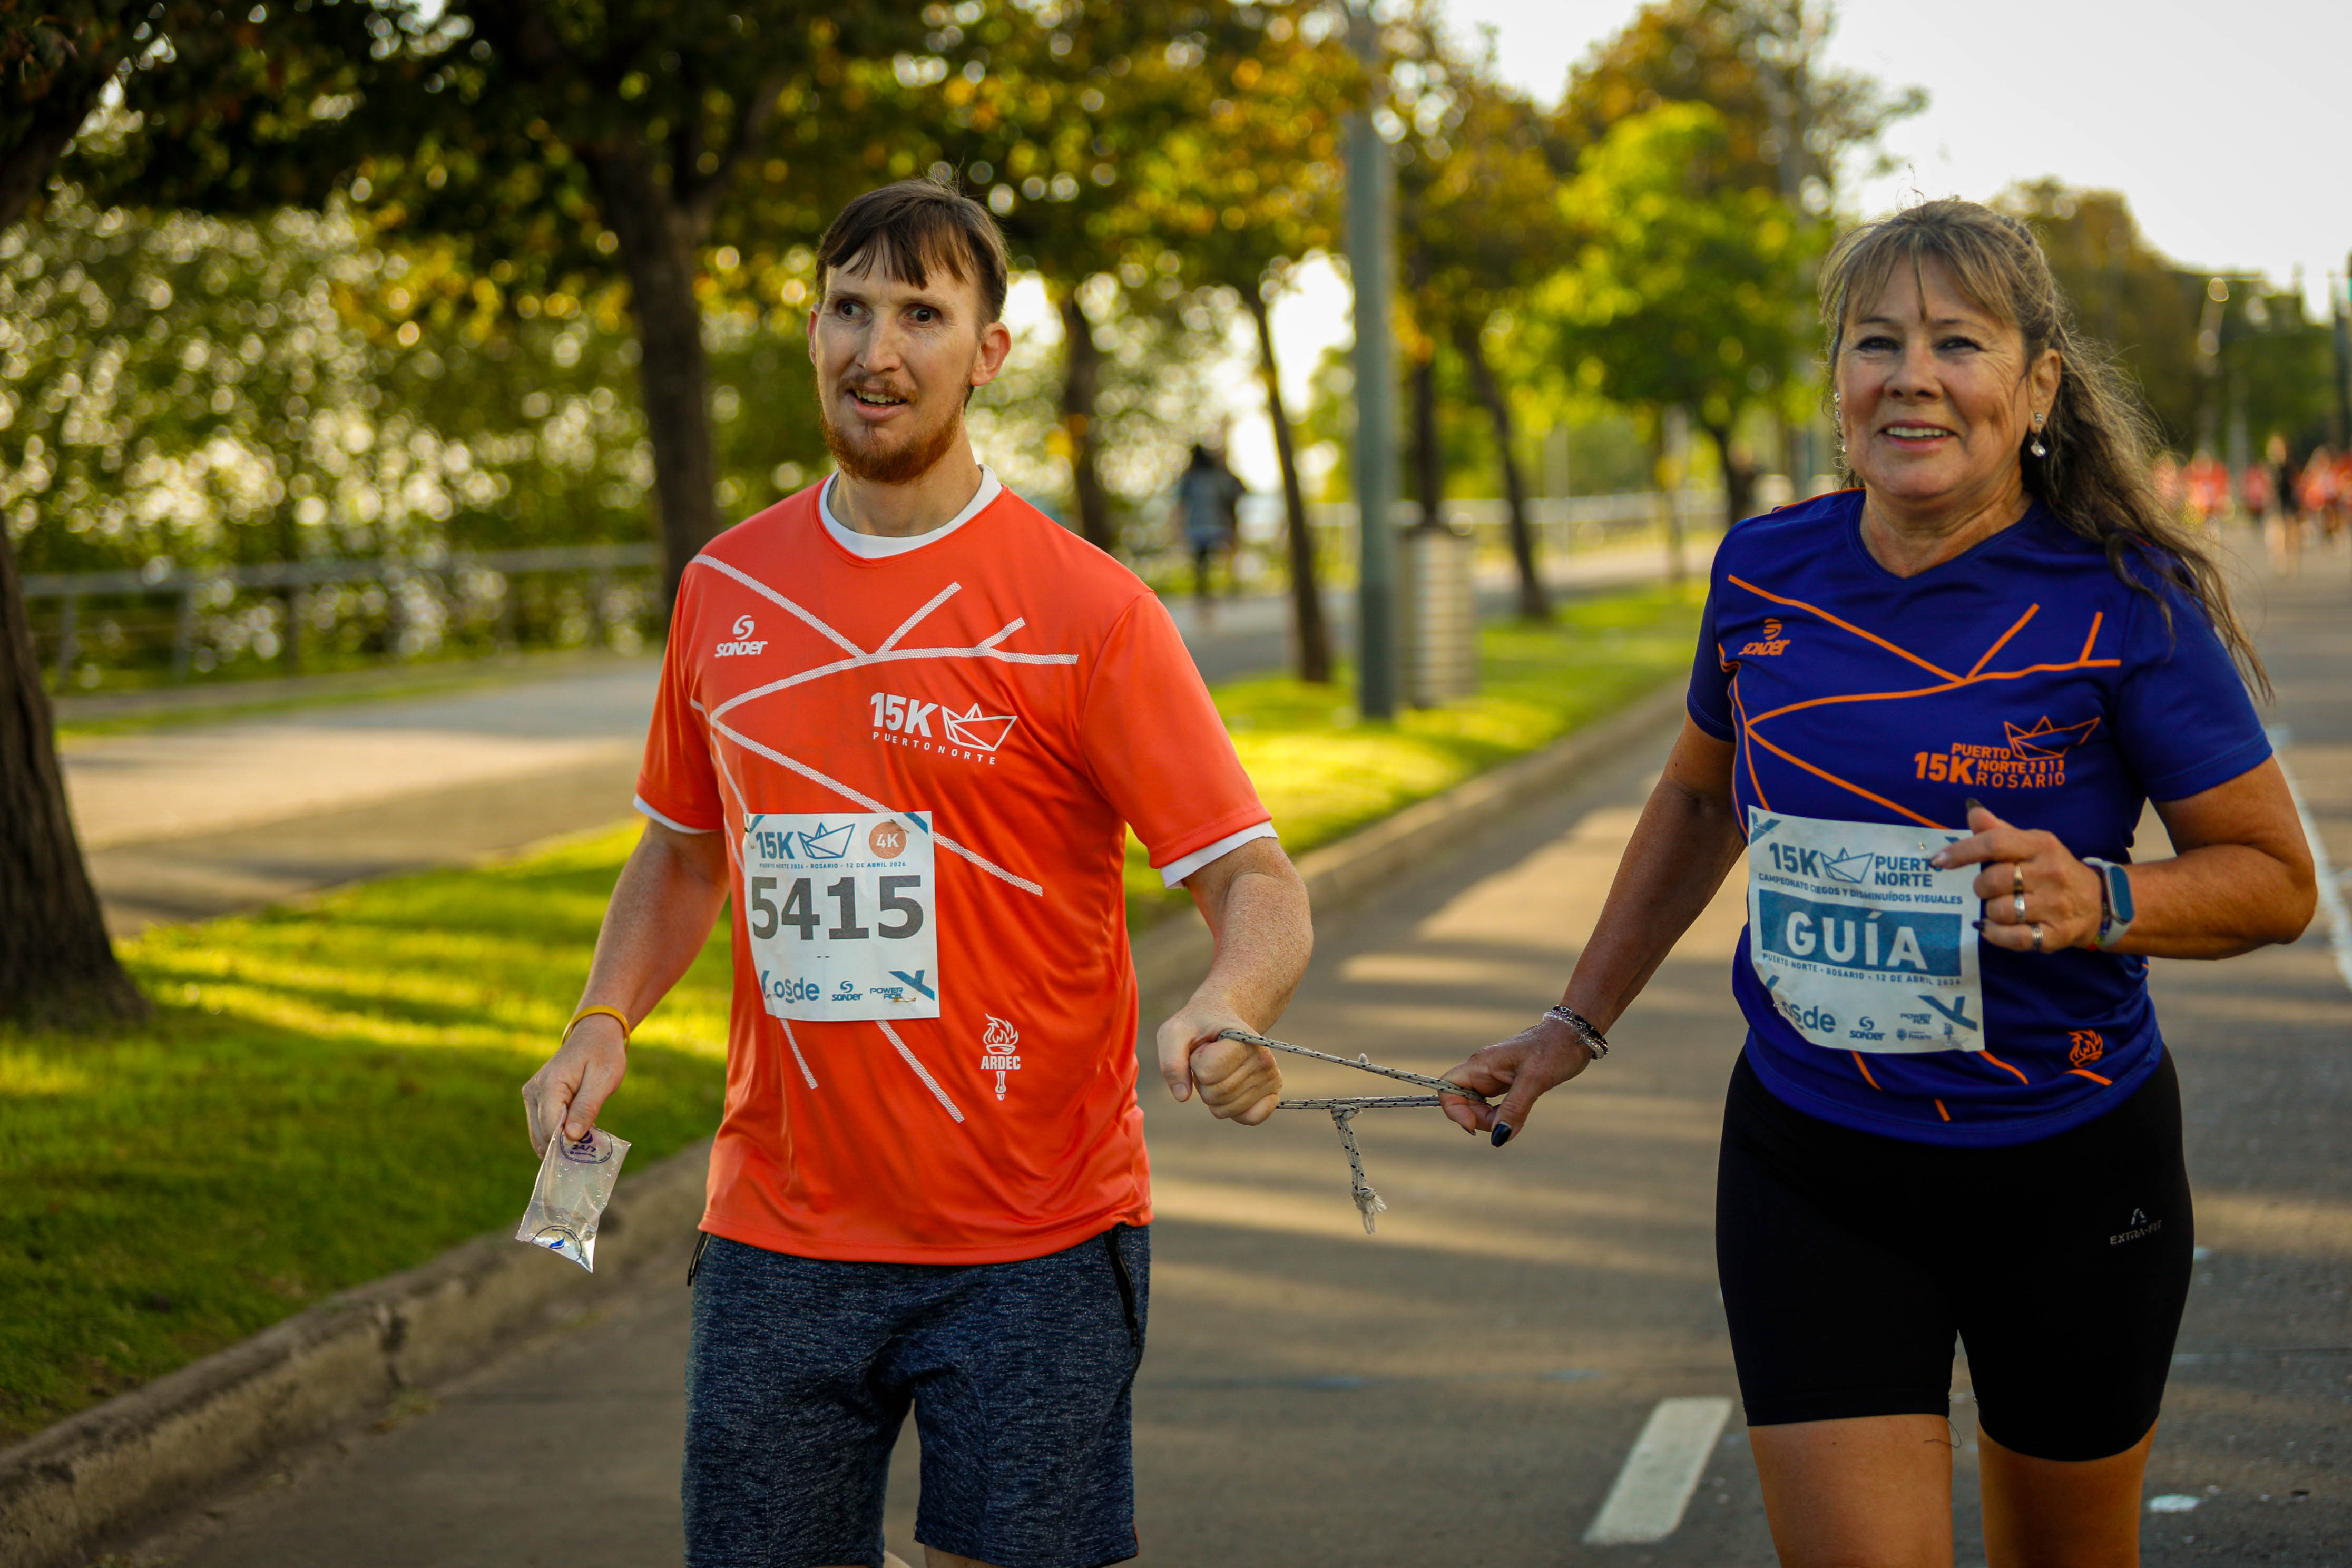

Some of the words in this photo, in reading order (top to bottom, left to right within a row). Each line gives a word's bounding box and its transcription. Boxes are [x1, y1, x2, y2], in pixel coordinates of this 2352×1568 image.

[870, 692, 938, 738] 15K
[873, 732, 931, 751] PUERTO
[937, 745, 996, 765] NORTE
[1952, 742, 2011, 760] PUERTO
[1914, 752, 1976, 785] 15K
[1975, 771, 2066, 789] ROSARIO
[1977, 759, 2027, 775] NORTE
[756, 831, 795, 859] 15K
[876, 833, 899, 847] 4K
[1769, 842, 1820, 879] 15K
[1759, 873, 1809, 891] CAMPEONATO
[1810, 884, 1840, 895] CIEGOS
[1914, 894, 1963, 905] VISUALES
[1875, 871, 1933, 887] NORTE
[752, 874, 924, 941] 5415
[1786, 910, 1928, 971] GUÍA
[1763, 953, 1789, 967] PUERTO
[1791, 962, 1818, 972] NORTE
[1826, 967, 1864, 980] ROSARIO
[1906, 975, 1933, 985] ABRIL
[773, 976, 820, 1002] osde
[981, 1055, 1021, 1070] ARDEC
